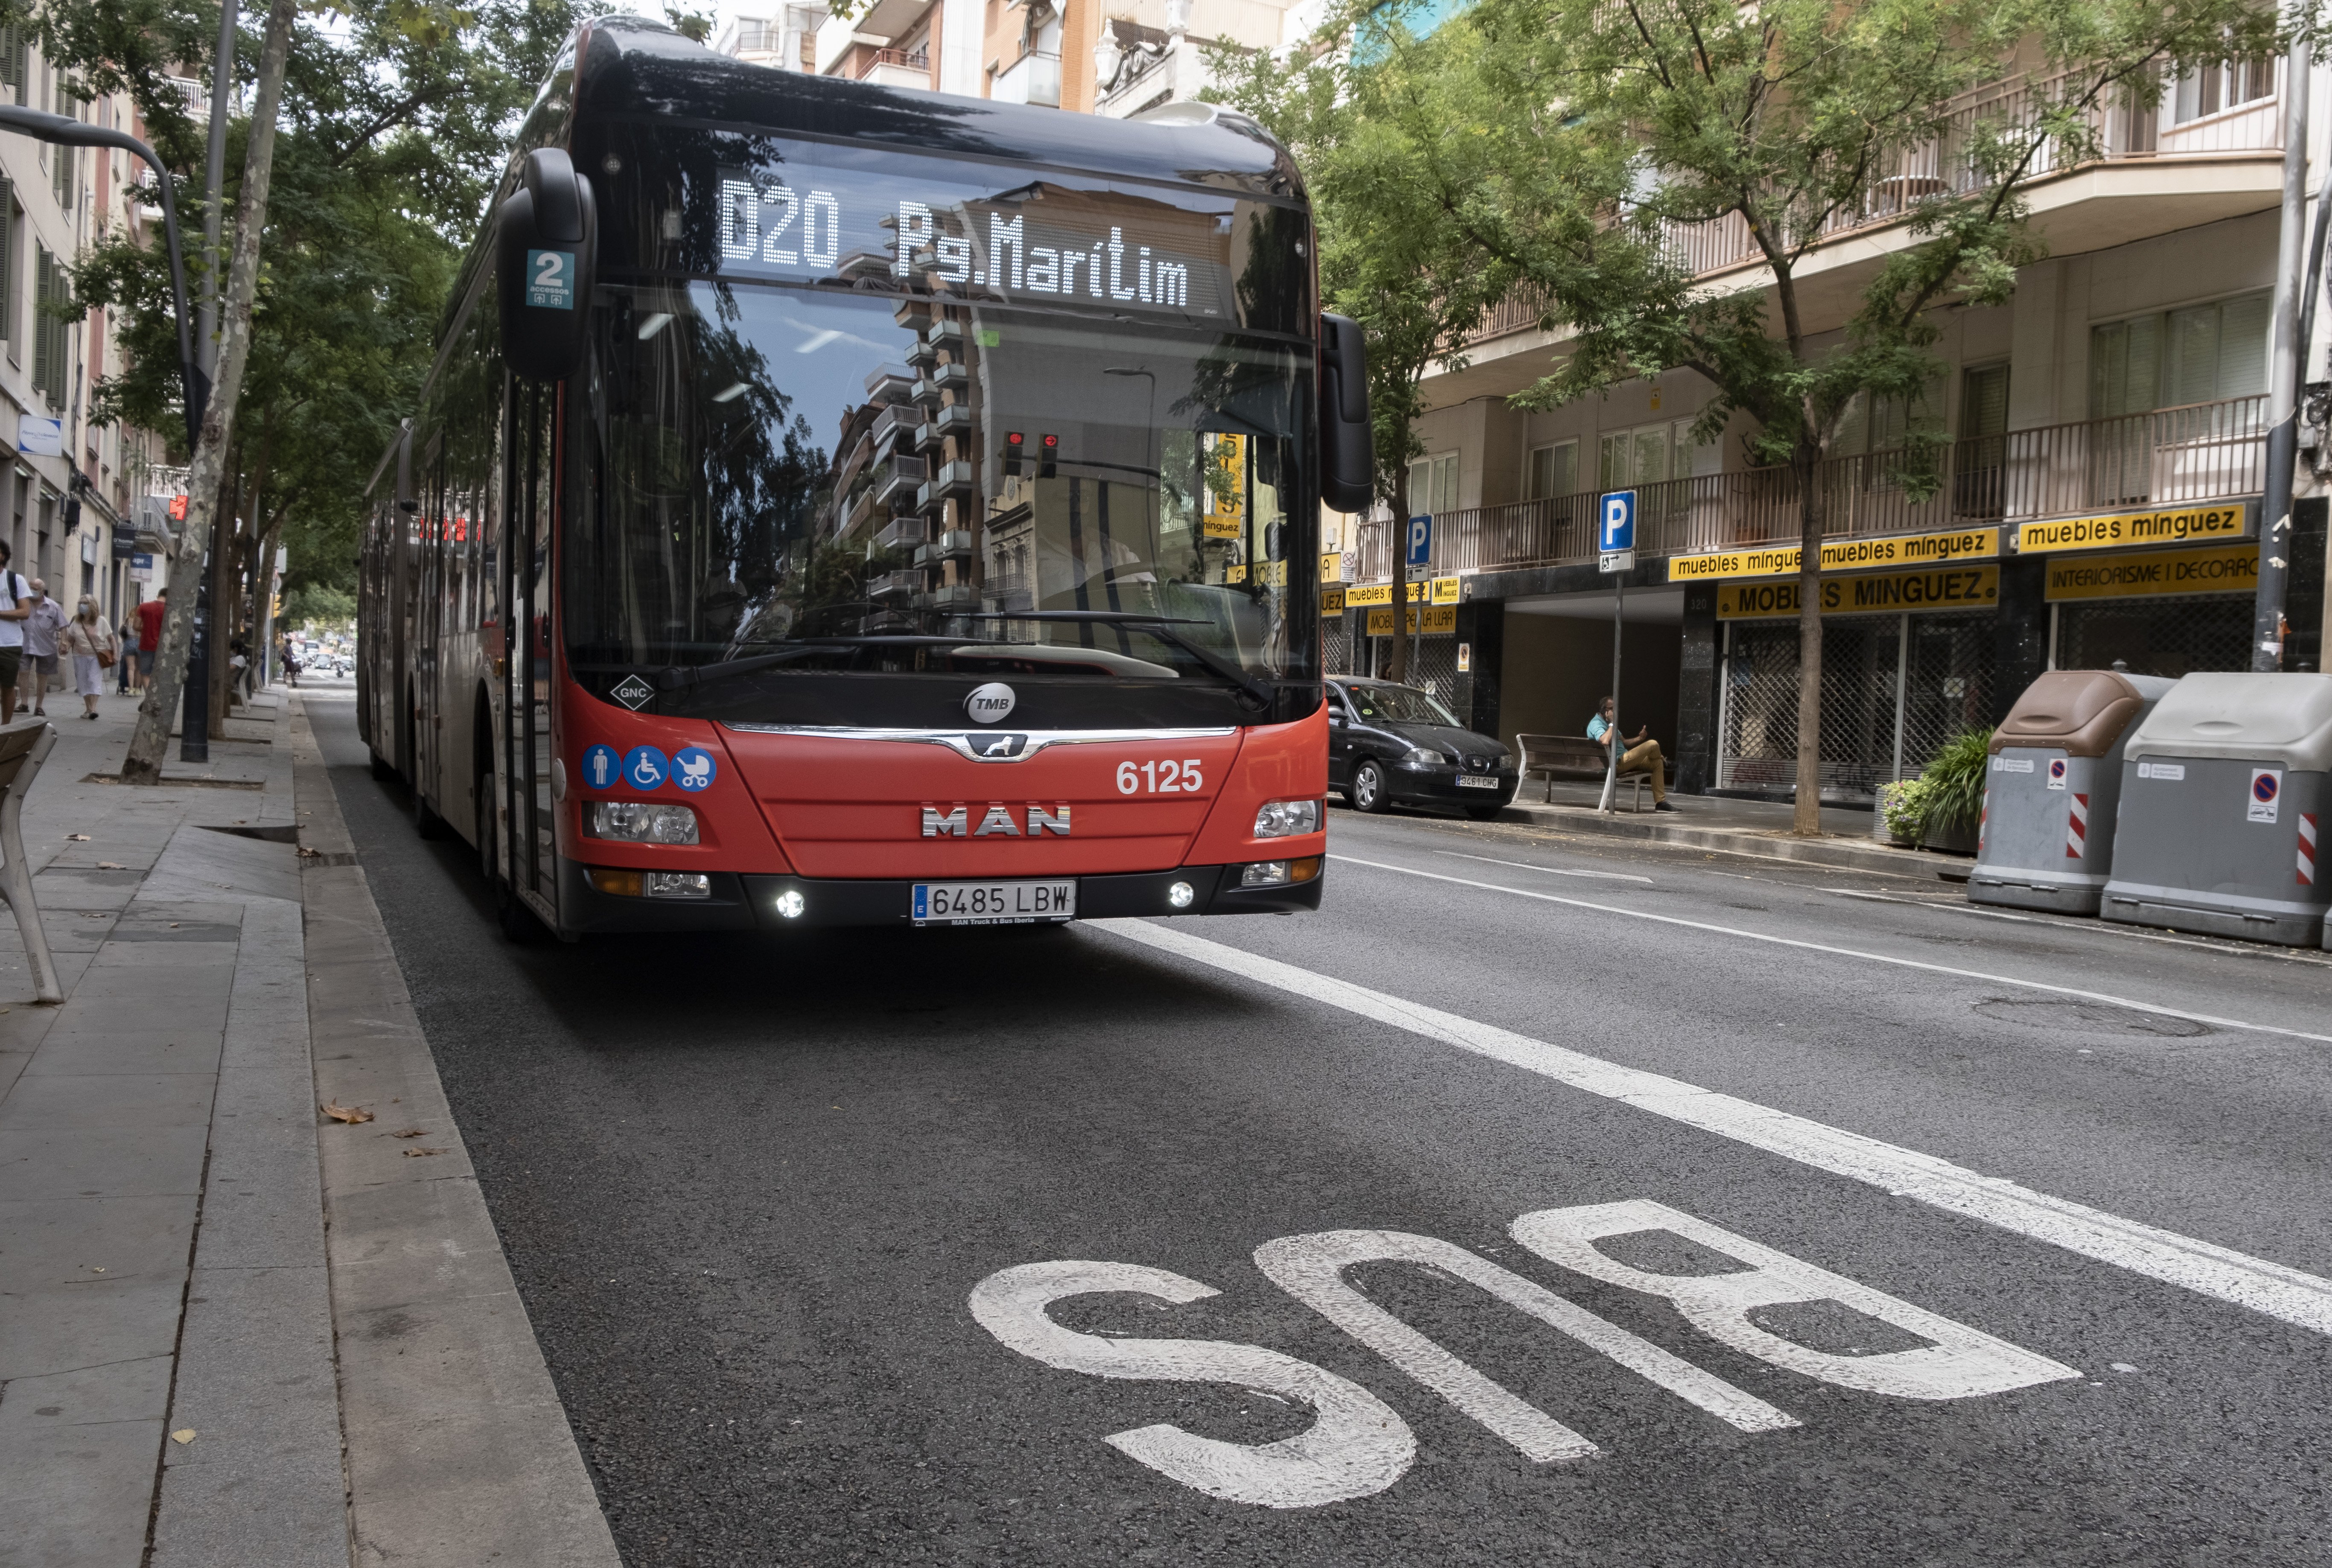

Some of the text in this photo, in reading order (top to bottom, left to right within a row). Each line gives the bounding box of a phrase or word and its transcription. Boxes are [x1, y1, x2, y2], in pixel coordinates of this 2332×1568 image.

[722, 179, 839, 268] D20
[535, 252, 563, 287] 2
[530, 286, 569, 295] accessos
[1606, 499, 1627, 545] P
[2028, 511, 2236, 545] muebles mínguez
[1411, 522, 1426, 559] P
[1679, 534, 1985, 574] muebles míngue muebles mínguez
[2052, 564, 2162, 588] INTERIORISME
[1349, 588, 1385, 601] muebles
[1691, 599, 1707, 609] 320
[1739, 572, 1982, 612] MOBLS MINGUEZ
[1371, 615, 1394, 629] MOBL
[1423, 612, 1431, 627] LA
[1434, 611, 1452, 627] LLAR
[620, 688, 647, 697] GNC
[976, 699, 1009, 710] TMB
[1116, 759, 1203, 794] 6125
[1461, 776, 1480, 786] 9461
[1483, 778, 1497, 787] CHG
[921, 807, 1070, 837] MAN
[933, 888, 1005, 915] 6485
[1016, 885, 1068, 912] LBW
[968, 1198, 2085, 1509] BUS
